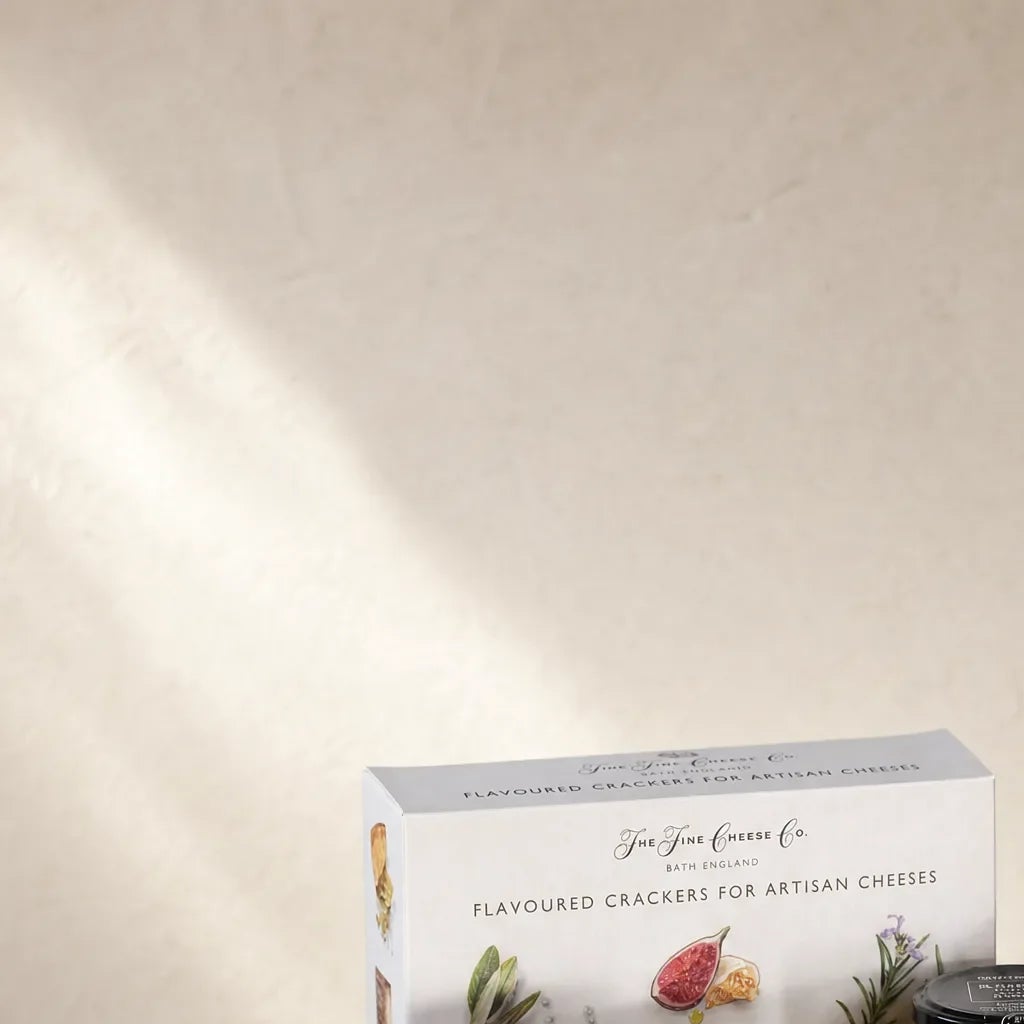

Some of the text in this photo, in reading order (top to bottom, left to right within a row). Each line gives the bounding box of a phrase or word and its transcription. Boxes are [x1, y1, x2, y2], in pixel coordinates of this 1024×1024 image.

[463, 763, 921, 799] FLAVOURED CRACKERS FOR ARTISAN CHEESES
[666, 858, 760, 873] BATH ENGLAND
[473, 870, 938, 918] FLAVOURED CRACKERS FOR ARTISAN CHEESES
